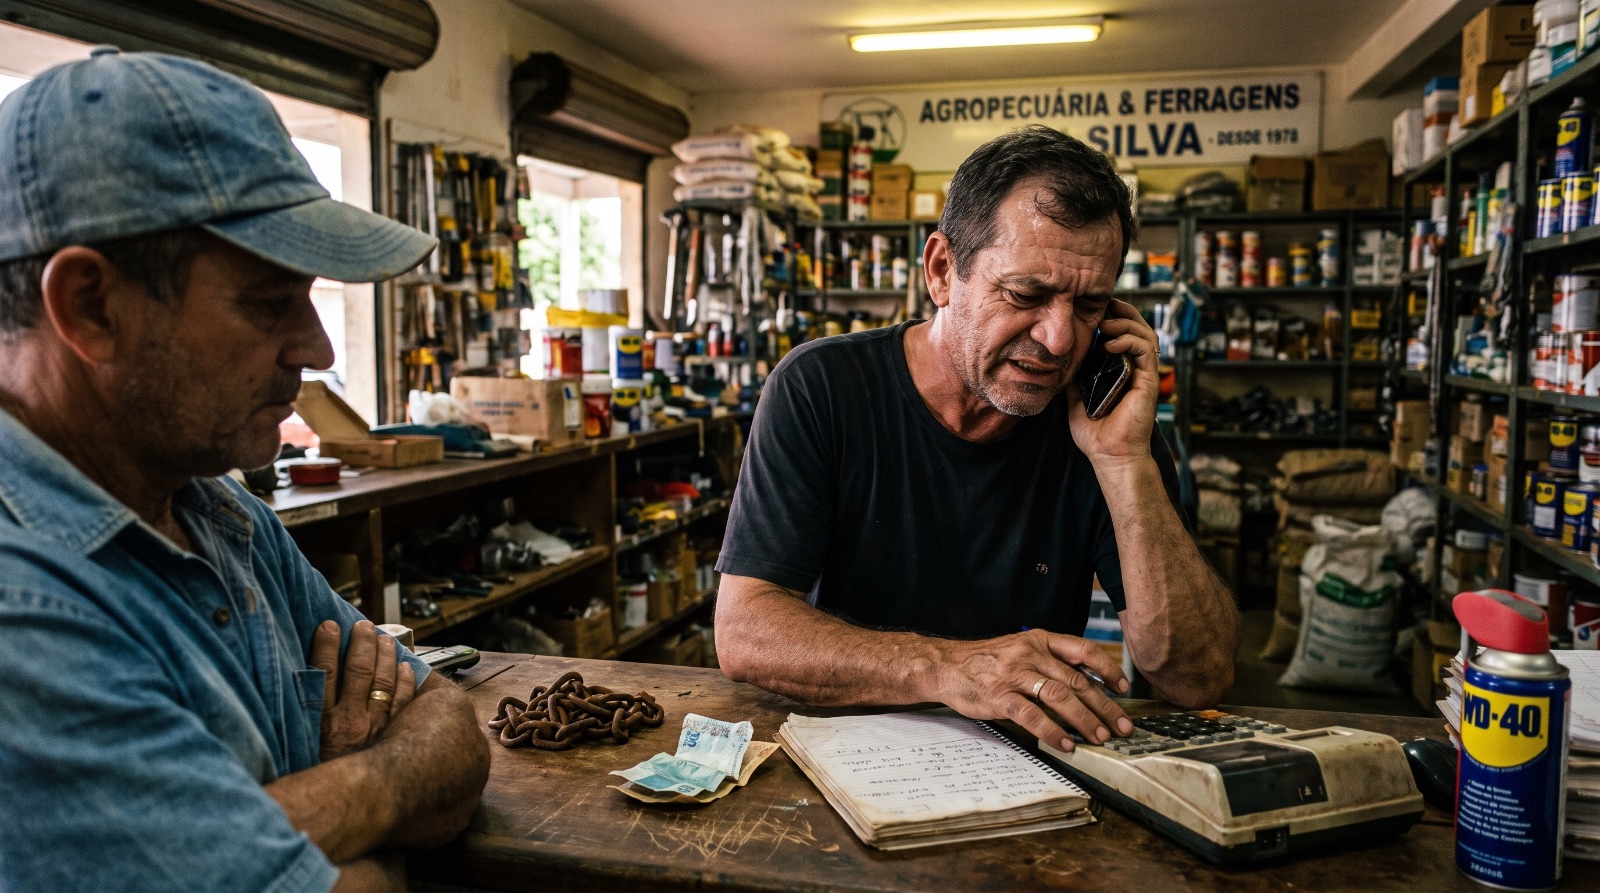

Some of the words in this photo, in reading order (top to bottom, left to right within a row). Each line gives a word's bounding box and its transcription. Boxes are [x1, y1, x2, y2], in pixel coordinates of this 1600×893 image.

[919, 87, 1109, 123] AGROPECUÁRIA
[1118, 91, 1134, 115] &
[1145, 82, 1300, 115] FERRAGENS
[1088, 122, 1203, 156] SILVA
[1217, 129, 1262, 146] DESDE
[1464, 690, 1542, 738] WD-40
